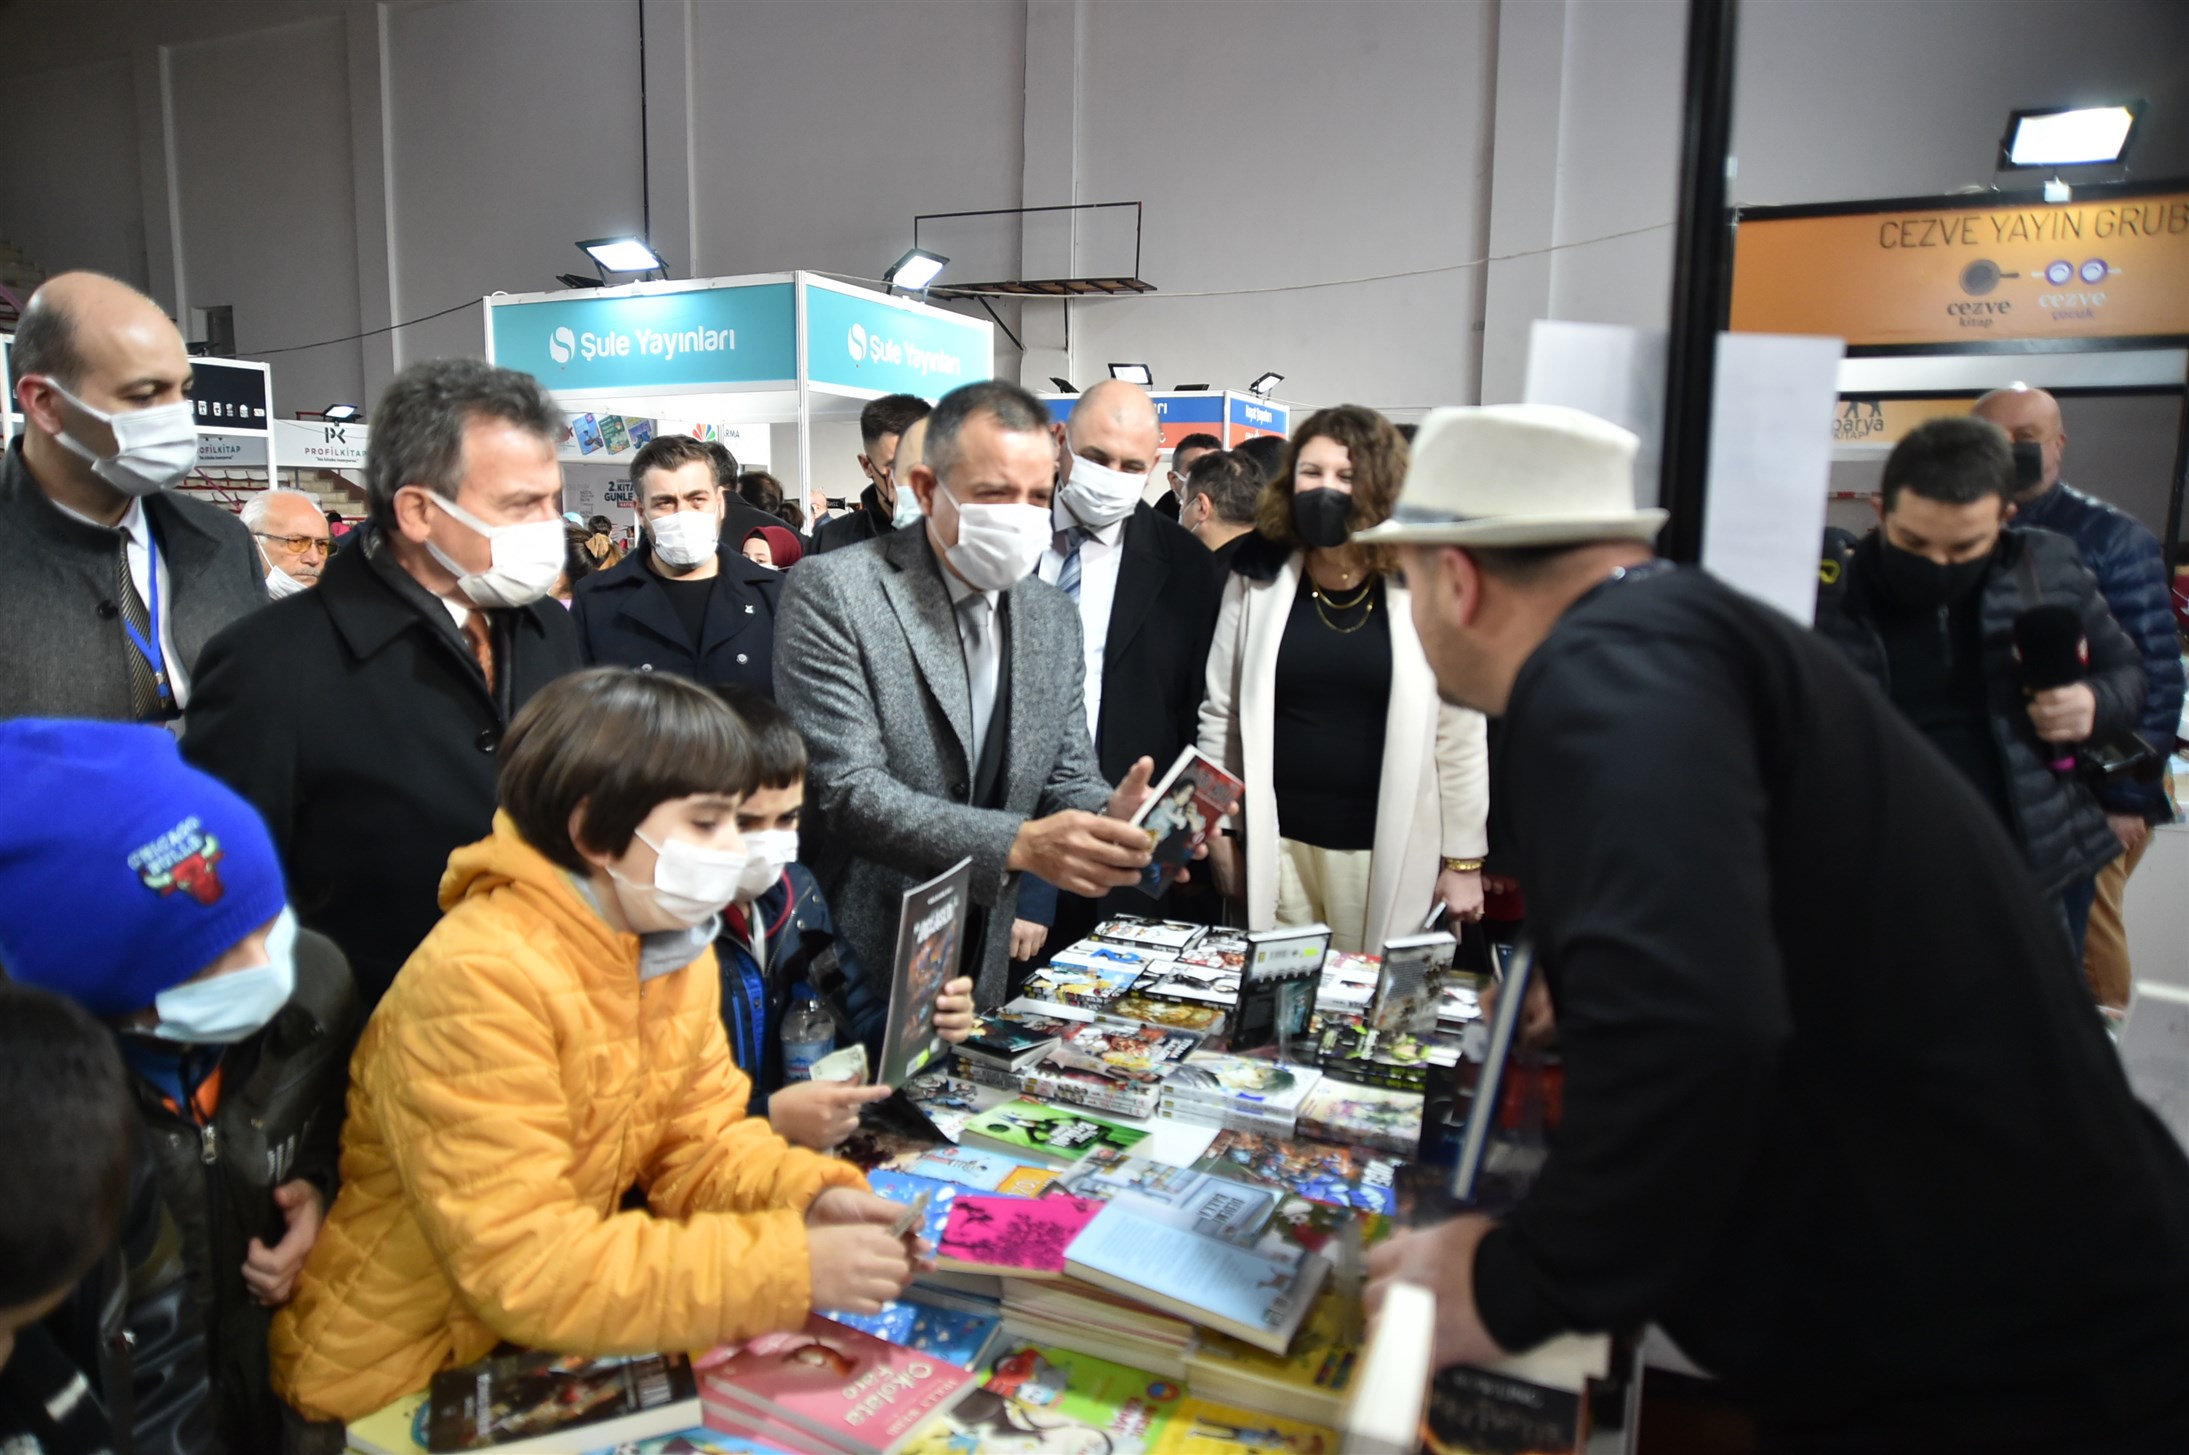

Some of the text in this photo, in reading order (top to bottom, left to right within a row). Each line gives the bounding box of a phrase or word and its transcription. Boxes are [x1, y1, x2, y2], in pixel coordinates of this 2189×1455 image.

[1879, 200, 2189, 250] CEZVE YAYIN GRUB
[1947, 300, 2012, 316] cezve
[2038, 290, 2108, 309] cezve
[1958, 315, 1994, 329] kitap
[580, 325, 736, 362] Şule Yayınları
[869, 334, 961, 377] Şule Yayınları
